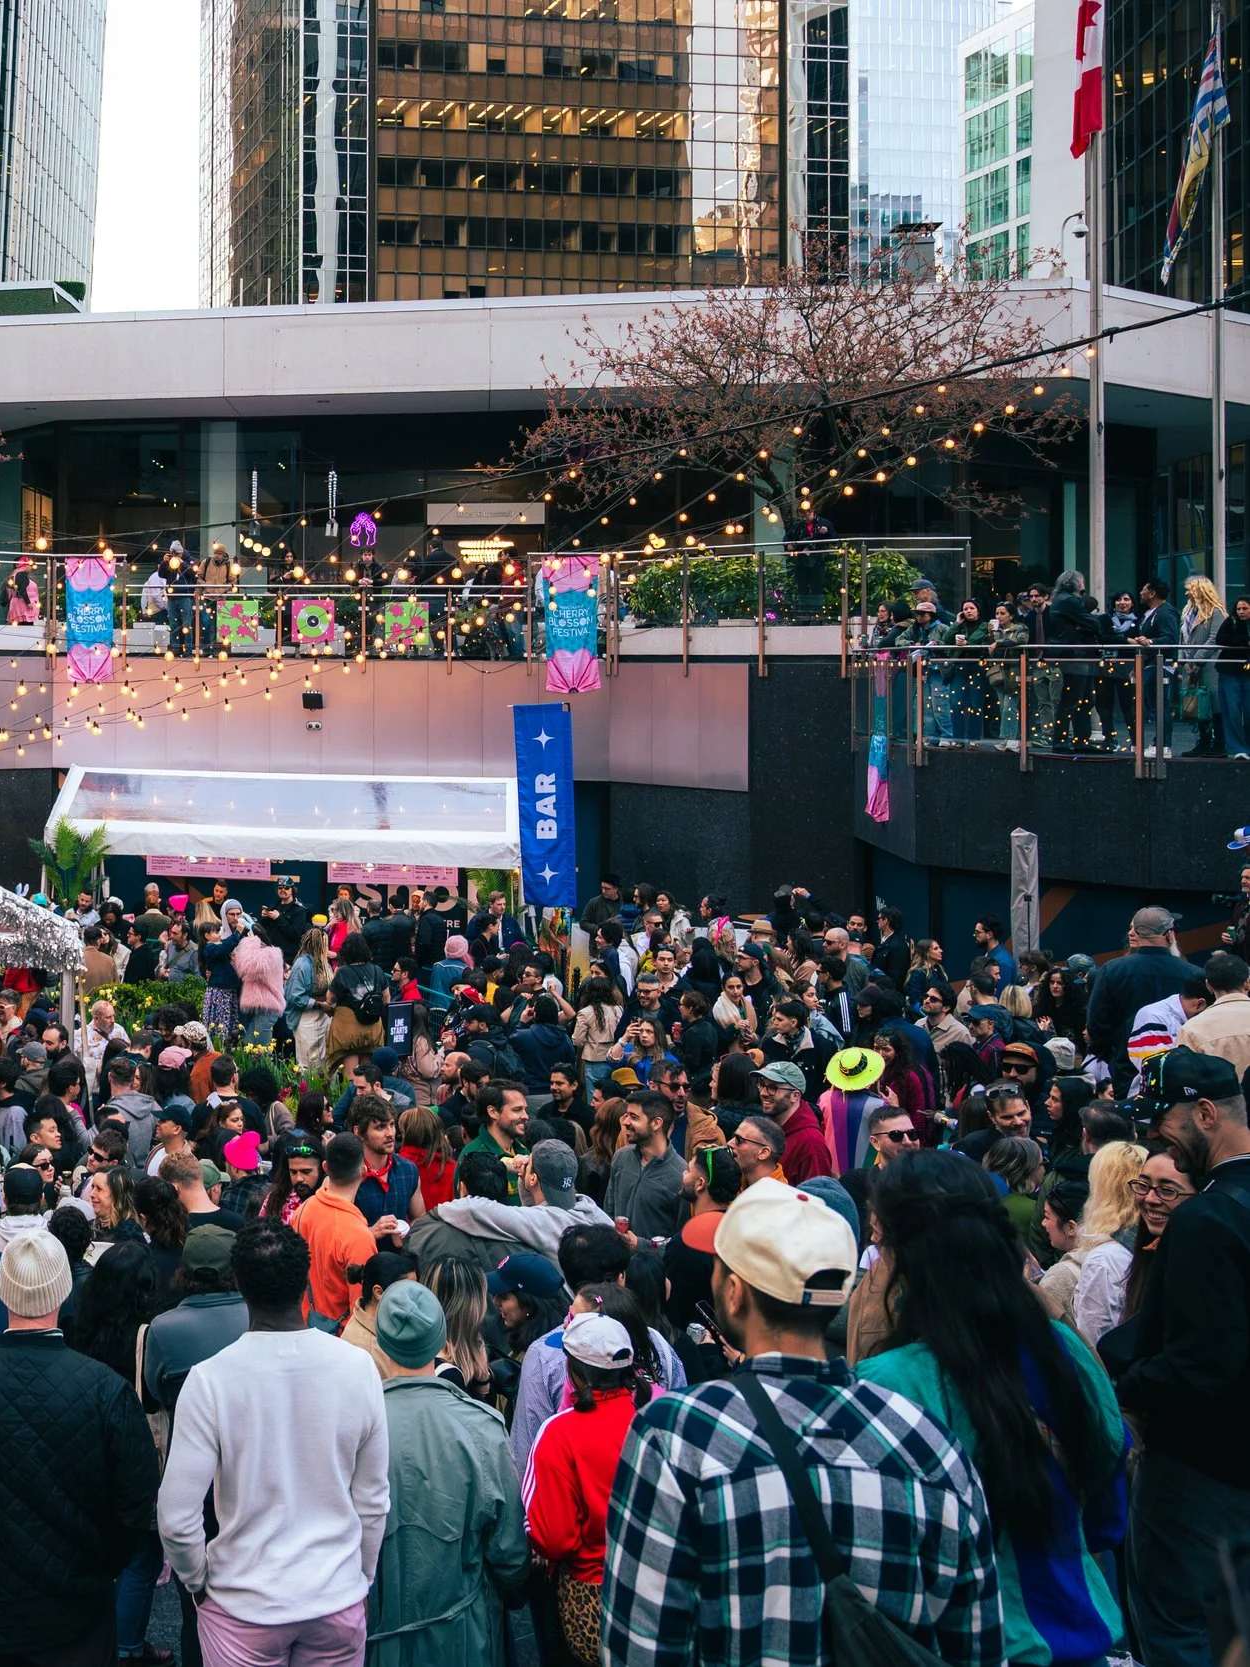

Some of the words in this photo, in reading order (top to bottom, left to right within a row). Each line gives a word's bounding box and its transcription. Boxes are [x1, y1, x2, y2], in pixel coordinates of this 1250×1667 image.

[552, 607, 590, 618] CHERRY
[67, 612, 111, 624] BLOSSOM
[71, 623, 107, 632] FESTIVAL
[535, 772, 558, 840] BAR
[394, 1018, 405, 1027] LINE
[390, 1025, 408, 1035] STARTS
[393, 1034, 405, 1043] HERE
